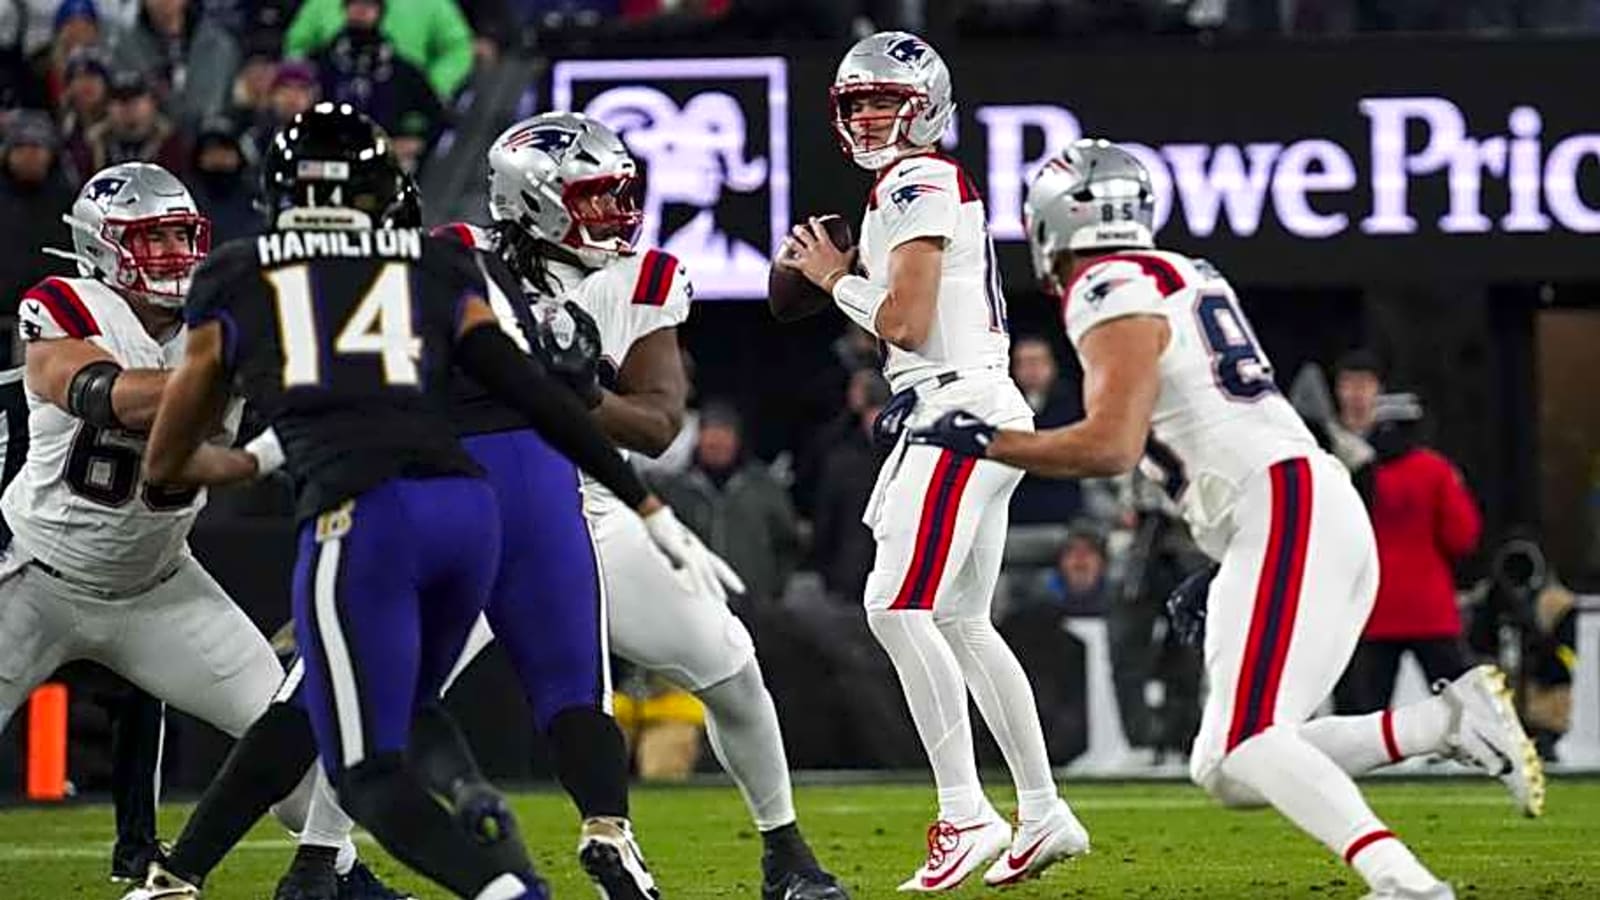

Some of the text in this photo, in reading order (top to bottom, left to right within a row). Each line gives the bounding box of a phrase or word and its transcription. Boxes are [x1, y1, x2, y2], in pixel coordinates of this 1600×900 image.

[1101, 203, 1133, 221] 85
[1358, 97, 1600, 234] Pric
[257, 227, 422, 265] HAMILTON
[260, 261, 423, 390] 14
[62, 420, 208, 513] 6
